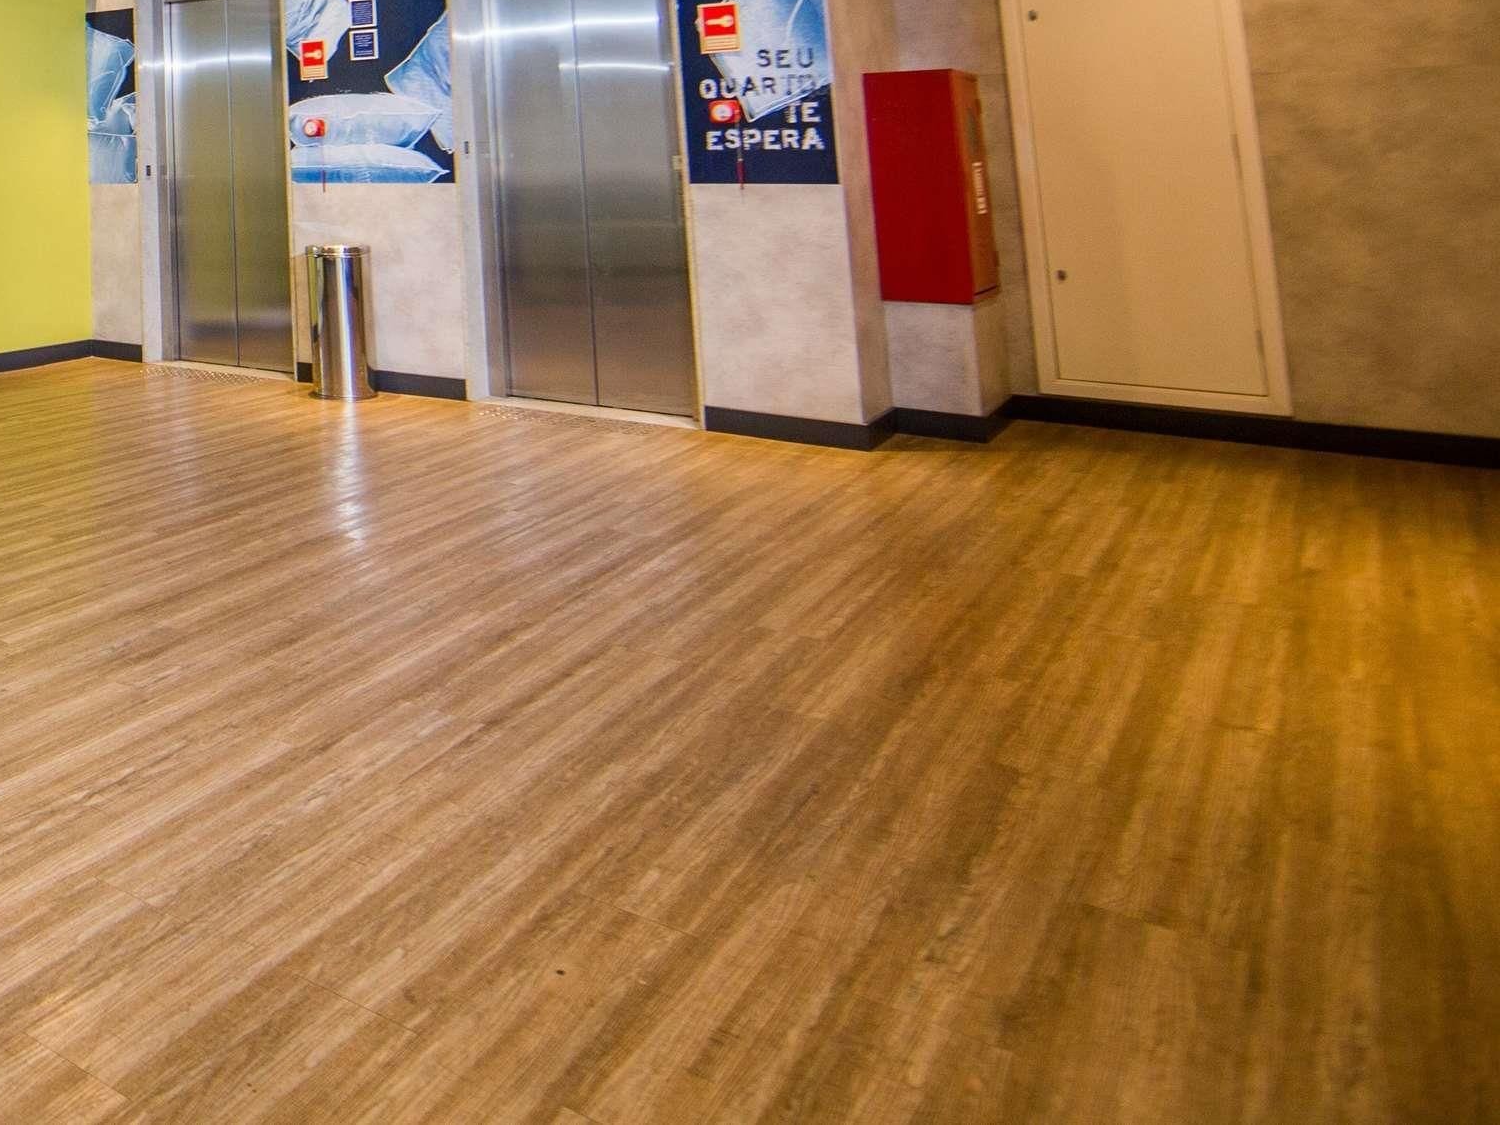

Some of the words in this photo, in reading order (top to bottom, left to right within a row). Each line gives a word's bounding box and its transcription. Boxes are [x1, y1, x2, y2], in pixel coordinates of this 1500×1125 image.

[757, 48, 814, 68] SEU
[786, 101, 821, 123] TE
[705, 127, 825, 151] ESPERA
